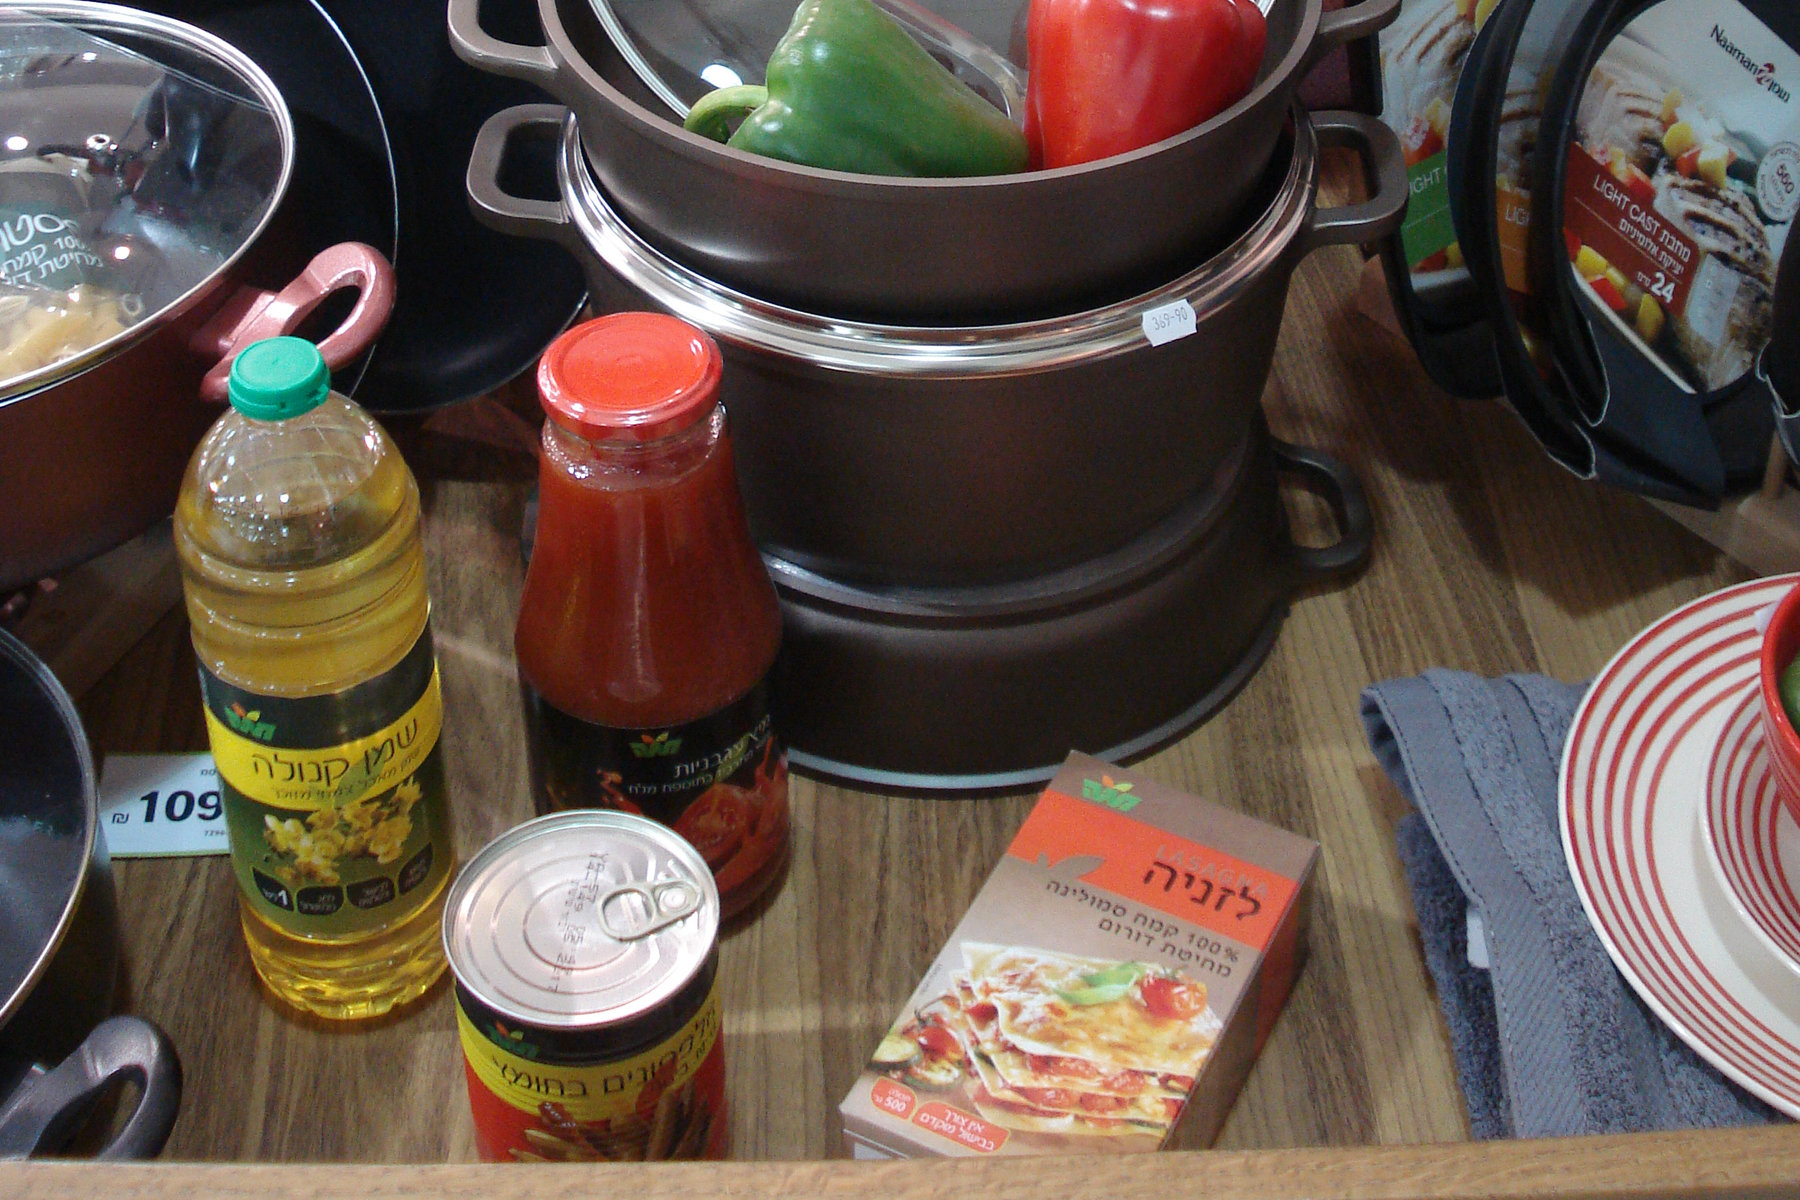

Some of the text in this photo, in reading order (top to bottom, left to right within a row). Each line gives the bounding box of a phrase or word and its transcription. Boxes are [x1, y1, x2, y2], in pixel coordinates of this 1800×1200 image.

[1710, 23, 1759, 75] Naaman
[1767, 79, 1791, 103] נעמן
[1408, 167, 1441, 196] IGHT
[1593, 174, 1691, 263] LIGHT CAST מחבת
[1651, 271, 1676, 303] 24
[251, 718, 418, 787] שמן קנולה
[140, 790, 223, 822] 109
[1143, 861, 1262, 921] לזניה
[1156, 845, 1269, 898] LASAGNA
[1046, 880, 1240, 963] 100% קמח סמולינה
[1098, 918, 1232, 978] מחיטת דורום
[884, 1097, 906, 1112] 500
